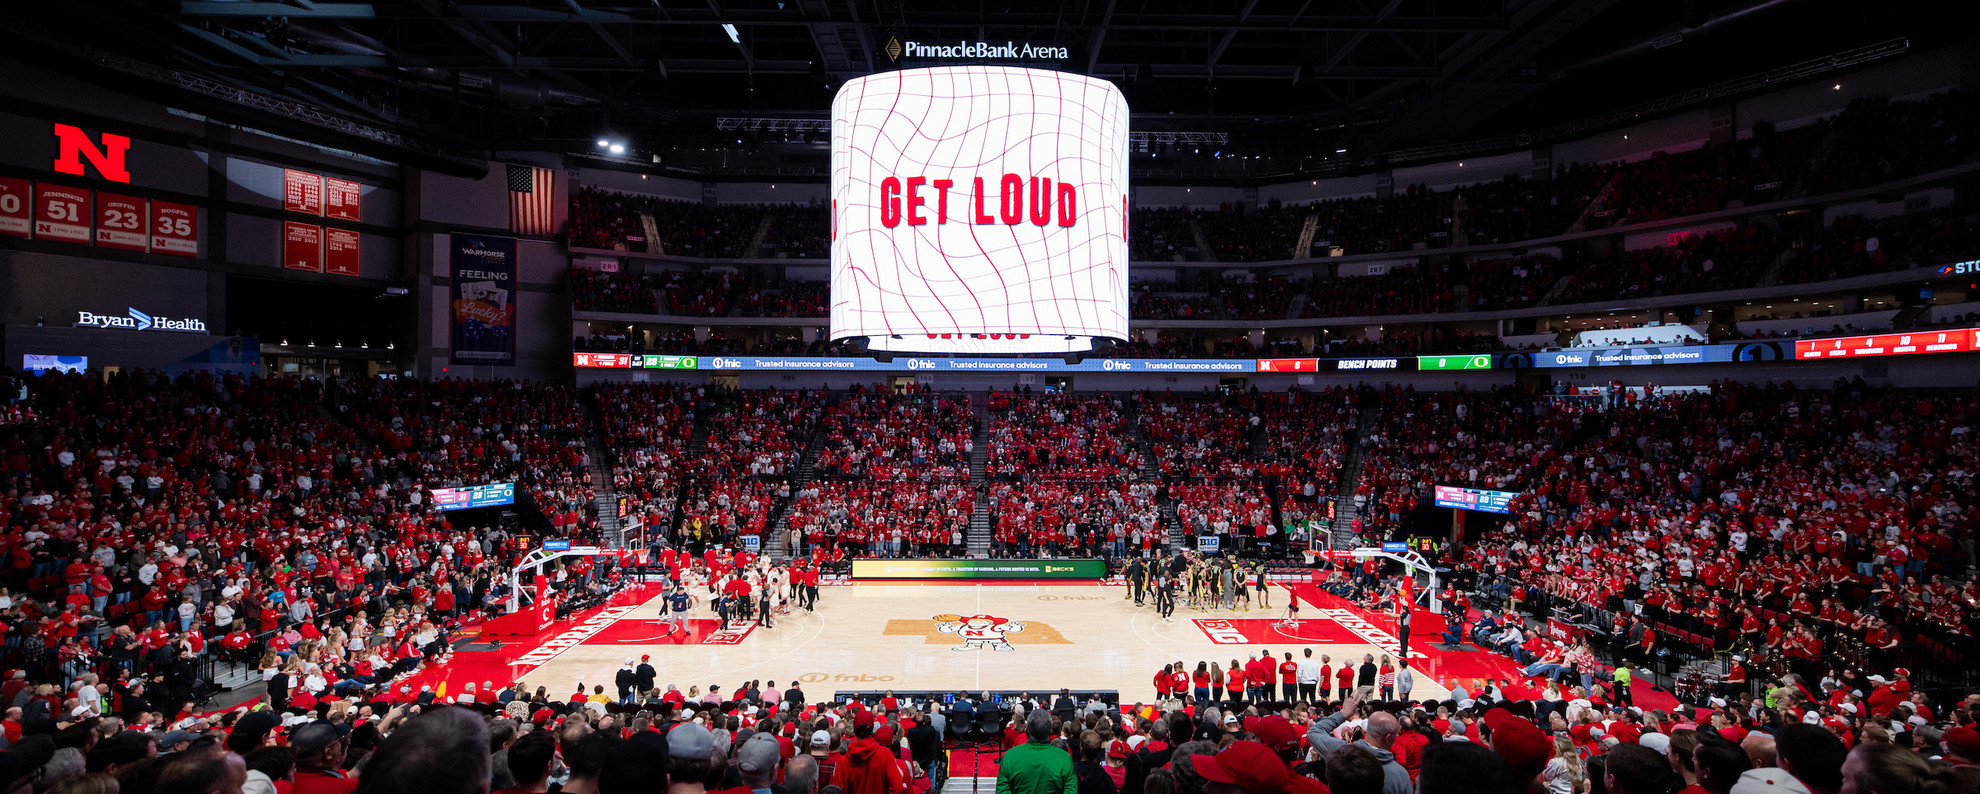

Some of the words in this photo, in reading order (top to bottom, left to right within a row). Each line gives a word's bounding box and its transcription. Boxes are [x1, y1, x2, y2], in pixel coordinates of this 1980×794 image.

[905, 40, 1018, 58] PinnacleBank
[1020, 43, 1068, 58] Arena
[54, 122, 130, 184] N
[43, 191, 84, 202] JENNINGS
[880, 176, 953, 228] GET
[974, 173, 1076, 228] LOUD
[47, 200, 79, 222] 51
[108, 202, 135, 210] GRIFFIN
[161, 208, 189, 217] HOOPER
[104, 210, 139, 229] 23
[39, 224, 51, 233] N
[158, 216, 191, 236] 35
[462, 248, 505, 257] WARHORSE
[460, 270, 508, 280] FEELING
[460, 302, 506, 322] Lucky?
[78, 311, 135, 328] Bryan
[152, 317, 206, 331] Health
[1811, 342, 1815, 350] 1
[1835, 340, 1841, 349] 4
[1866, 338, 1873, 347] 4
[1900, 336, 1911, 345] 10
[1938, 333, 1946, 343] 11
[578, 355, 588, 365] N
[618, 357, 628, 365] 31
[646, 357, 658, 366] 28
[682, 358, 694, 367] O
[724, 358, 741, 368] fnic
[919, 359, 935, 369] fnic
[1338, 360, 1365, 369] BENCH
[1366, 359, 1397, 368] POINTS
[1439, 359, 1446, 367] 0
[1474, 357, 1488, 367] O
[1567, 355, 1582, 363] fnic
[1115, 361, 1131, 370] fnic
[1260, 361, 1270, 370] N
[508, 605, 640, 665] NEBRASKA
[833, 673, 894, 683] fnbo
[1178, 673, 1186, 681] N
